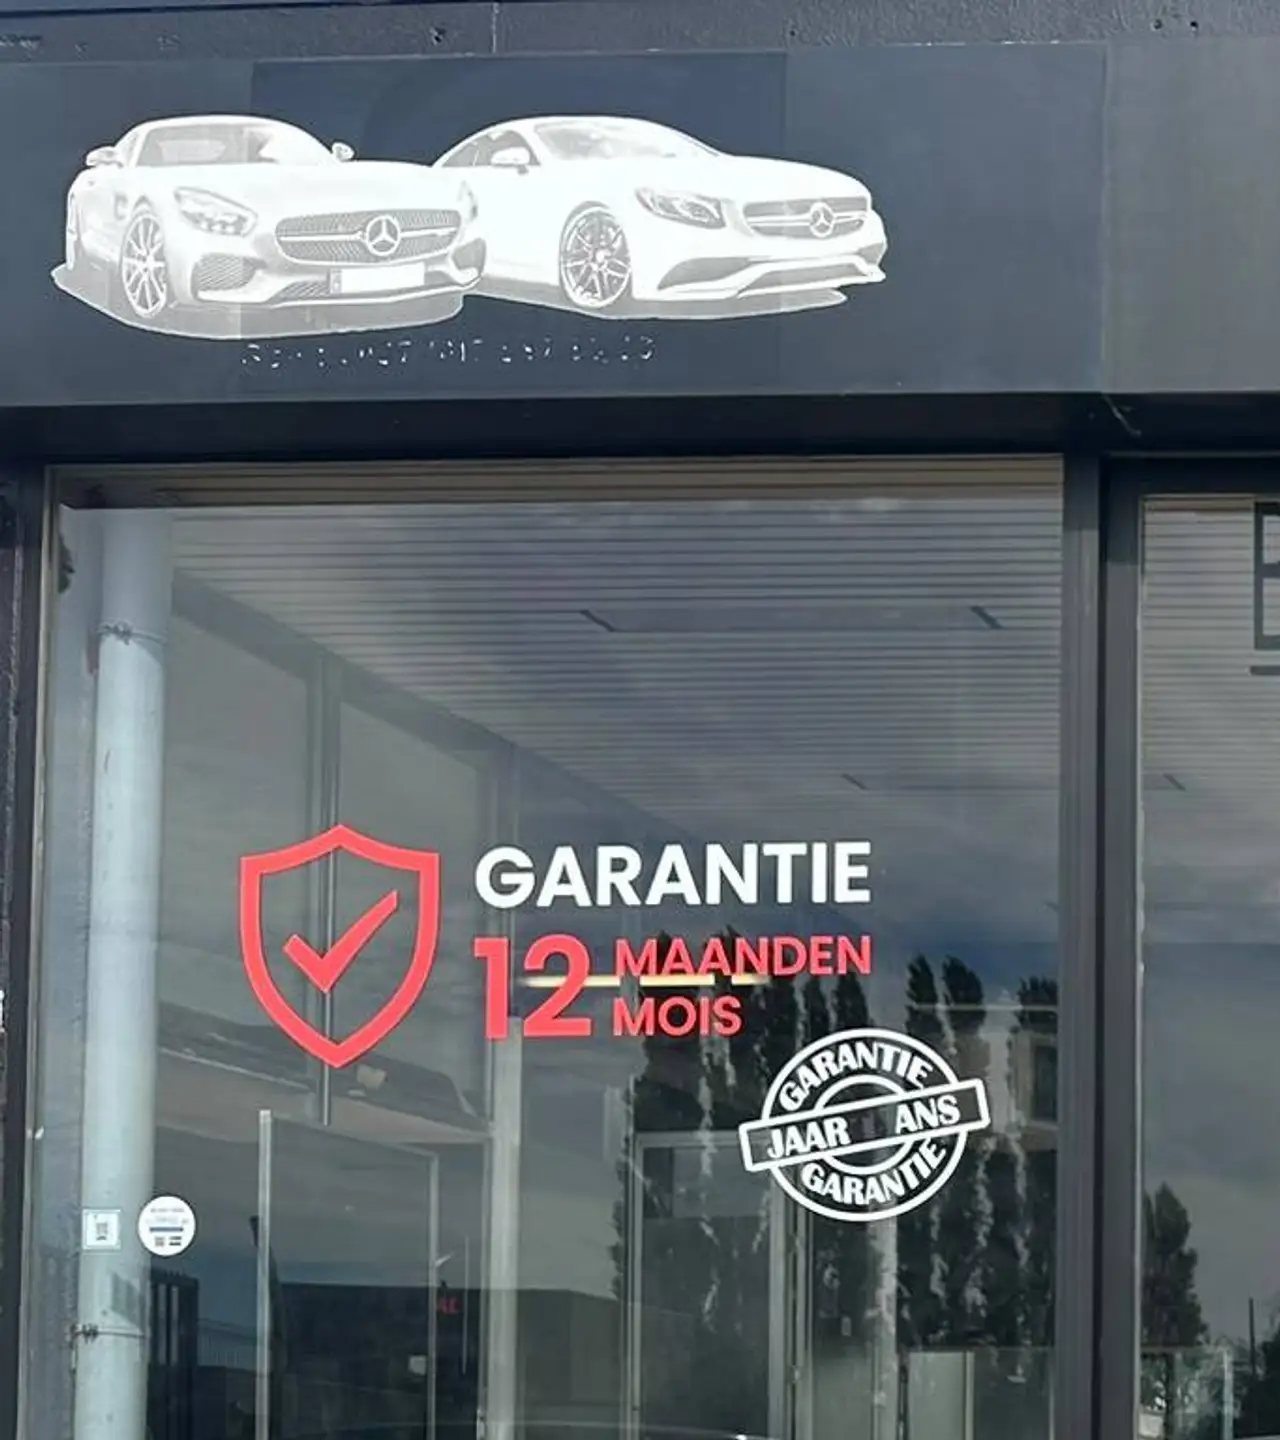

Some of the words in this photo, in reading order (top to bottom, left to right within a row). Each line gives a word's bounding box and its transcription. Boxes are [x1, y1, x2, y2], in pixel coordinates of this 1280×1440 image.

[474, 841, 872, 910] GARANTIE
[472, 933, 594, 1042] 12
[613, 934, 873, 979] MAANDEN
[611, 994, 743, 1037] MOIS
[778, 1040, 934, 1112] GARANTIE
[767, 1116, 850, 1158] JAAR
[895, 1094, 961, 1134] ANS
[800, 1137, 947, 1205] GARANTIE
